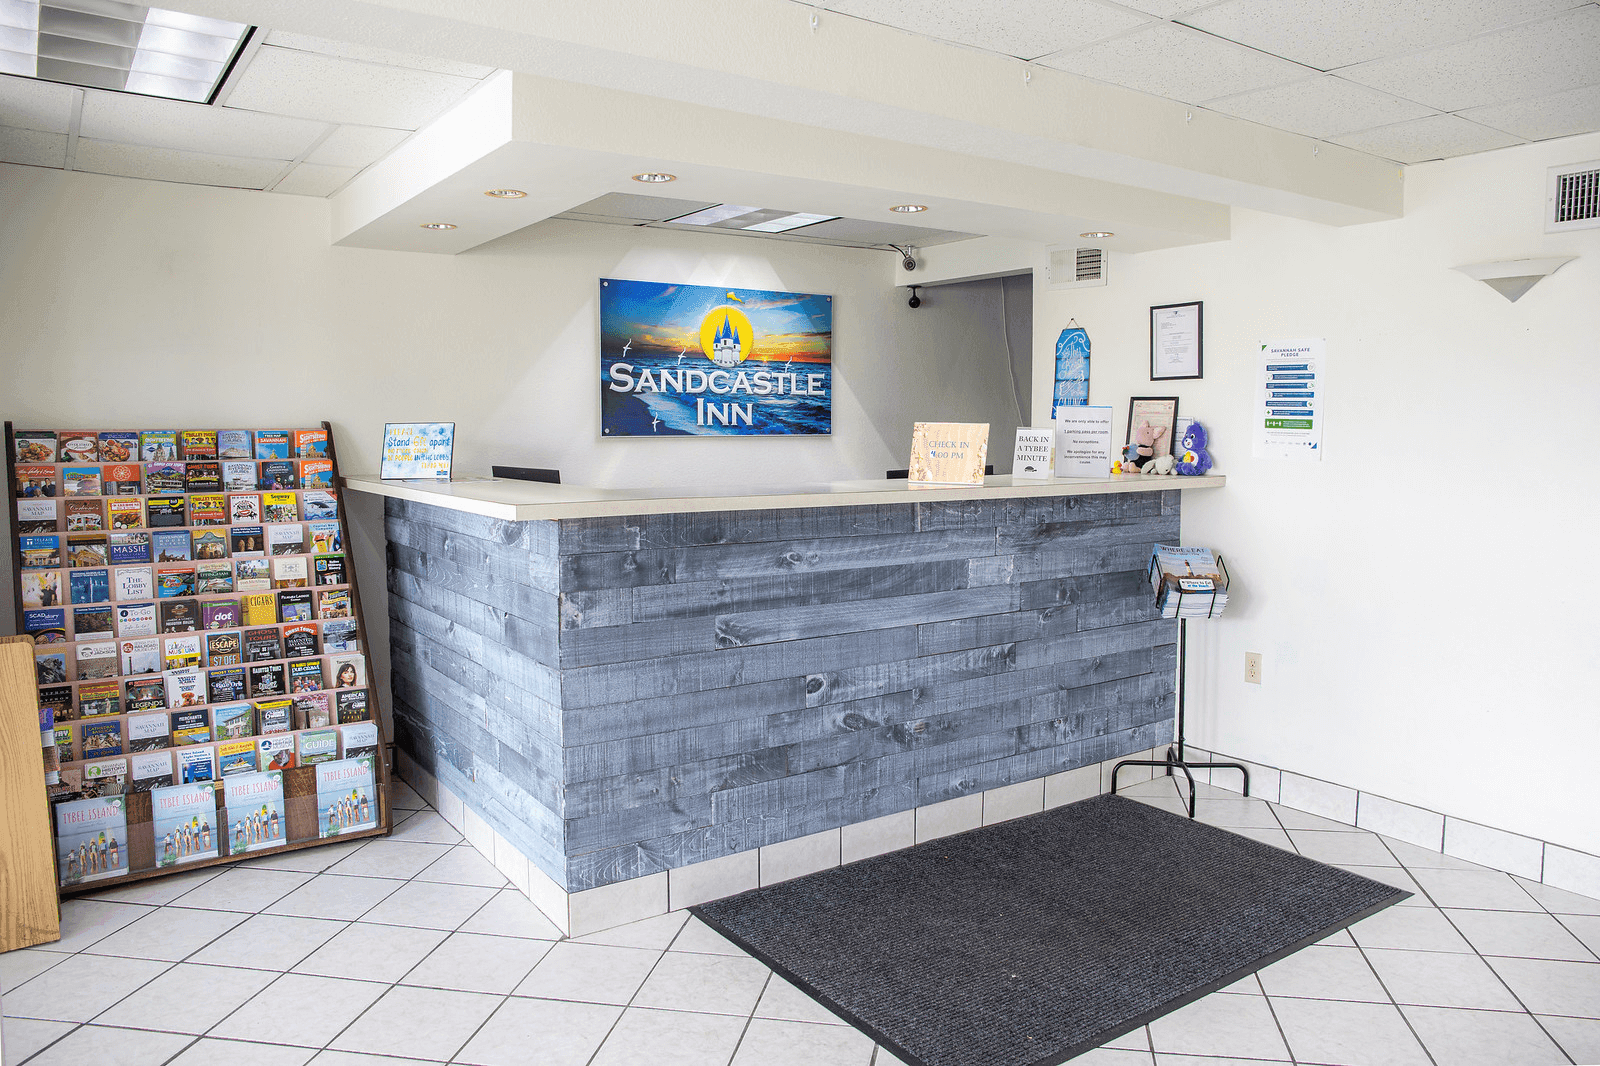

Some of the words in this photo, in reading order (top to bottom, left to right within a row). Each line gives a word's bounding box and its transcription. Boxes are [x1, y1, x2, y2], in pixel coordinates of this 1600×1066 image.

[609, 362, 826, 397] SANDCASTLE
[696, 398, 754, 426] INN
[929, 440, 956, 448] CHECK
[114, 545, 145, 553] MASSIE
[251, 596, 273, 606] CIGARS
[215, 612, 232, 620] dot
[214, 656, 222, 666] $7
[224, 655, 236, 665] OFF
[305, 740, 335, 749] GUIDE
[324, 770, 342, 782] TYBEE
[343, 766, 368, 778] ISLAND
[231, 785, 249, 797] TYBEE
[253, 780, 279, 793] ISLAND
[160, 796, 180, 808] TYBEE
[182, 792, 211, 806] ISLAND
[63, 810, 85, 824] TYBEE
[88, 806, 118, 820] ISLAND
